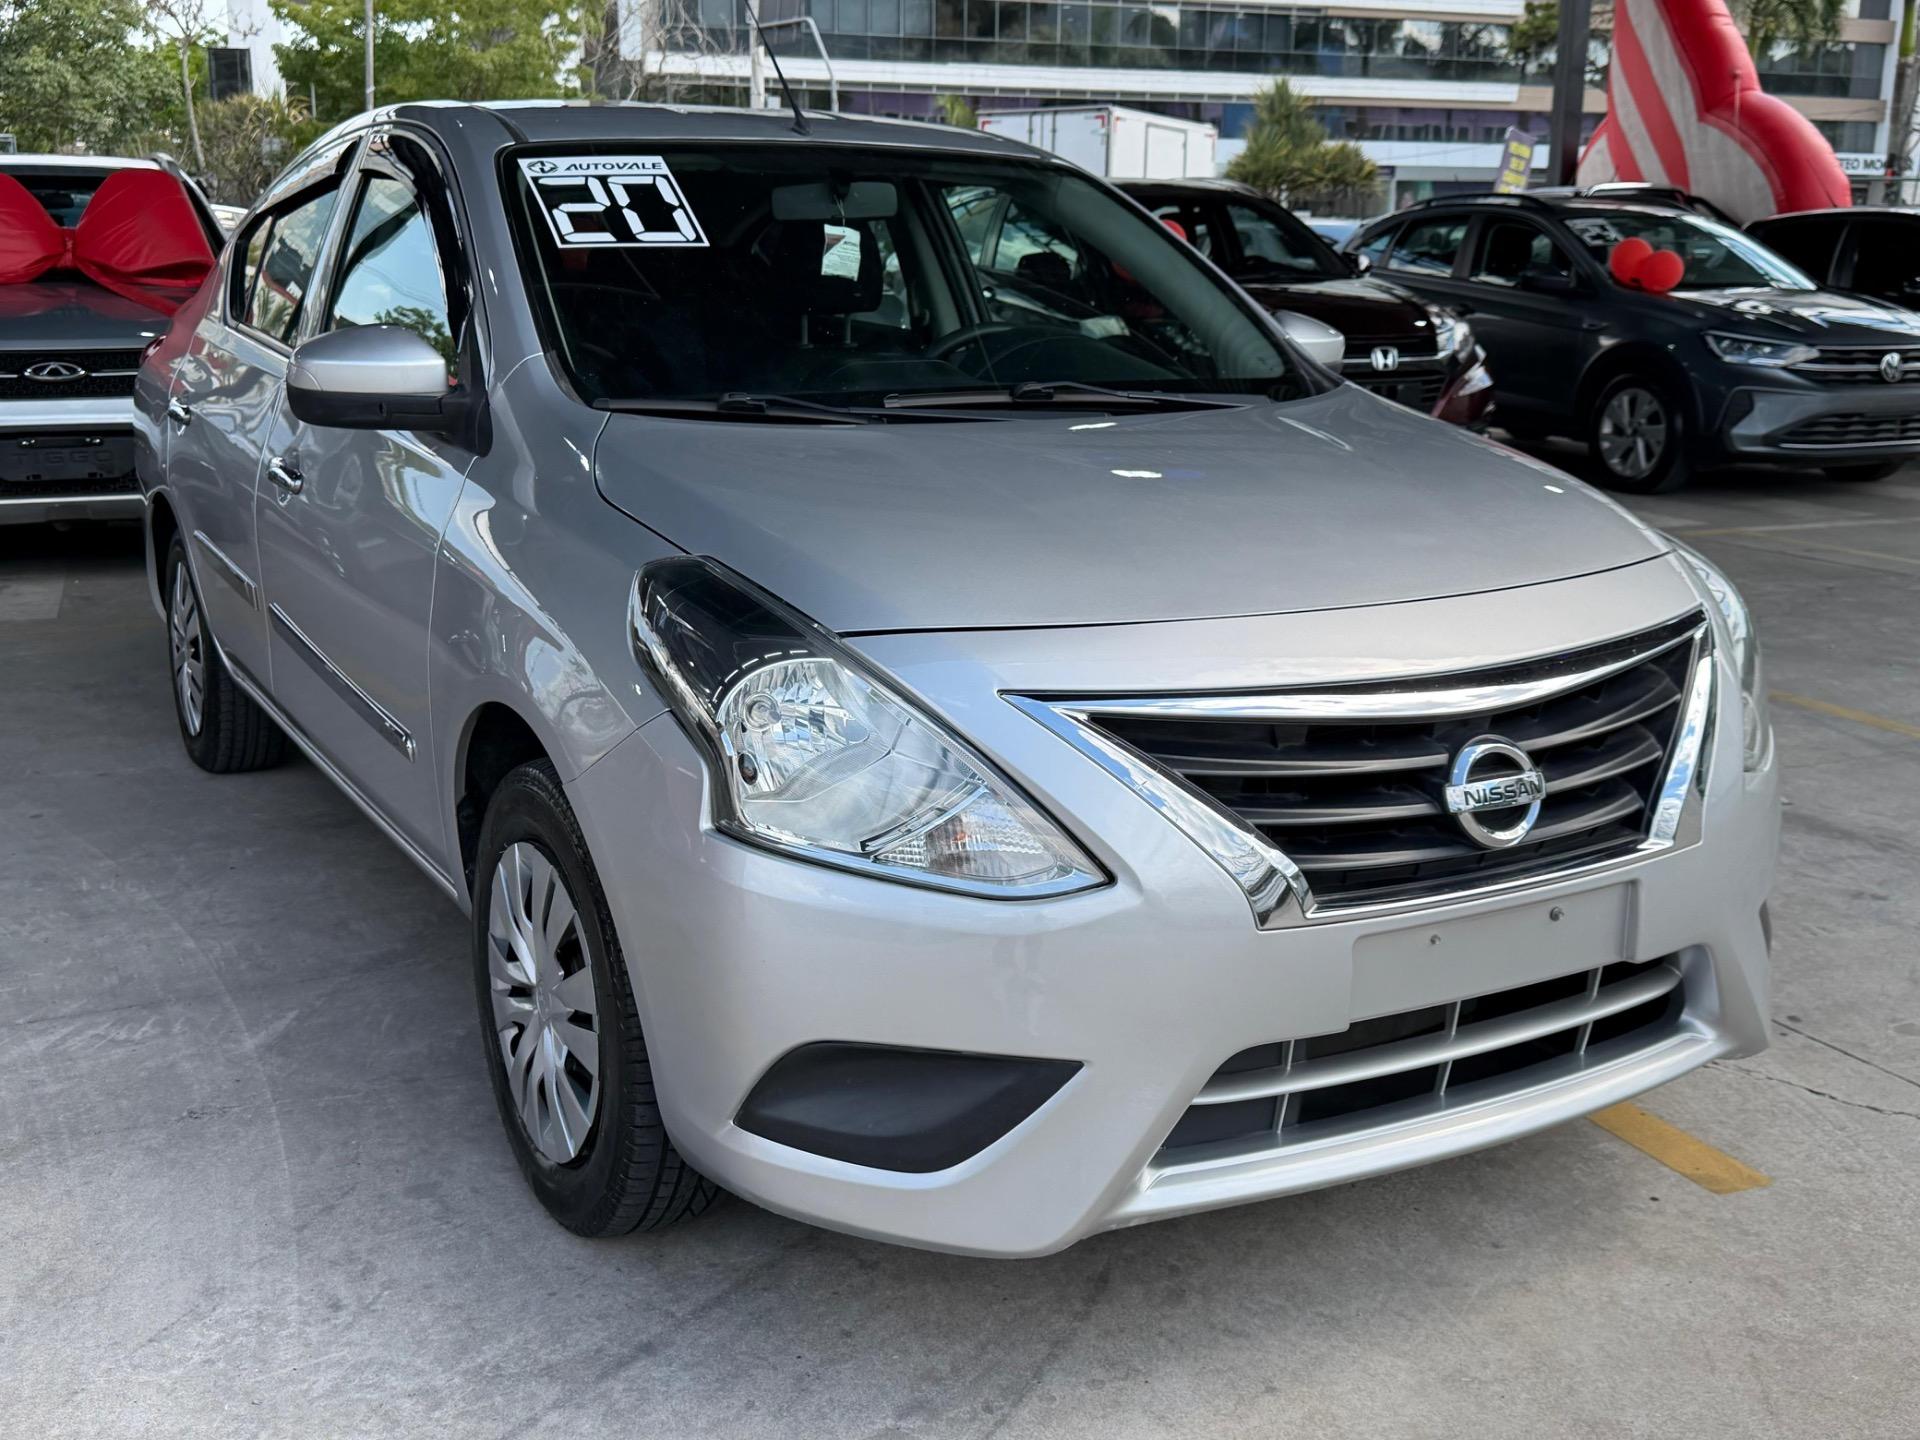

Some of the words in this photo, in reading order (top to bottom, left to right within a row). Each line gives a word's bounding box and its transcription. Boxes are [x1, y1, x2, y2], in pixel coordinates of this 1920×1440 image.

[564, 162, 663, 172] AUTOVALE
[538, 175, 697, 243] 20
[1463, 779, 1541, 806] NISSAN
